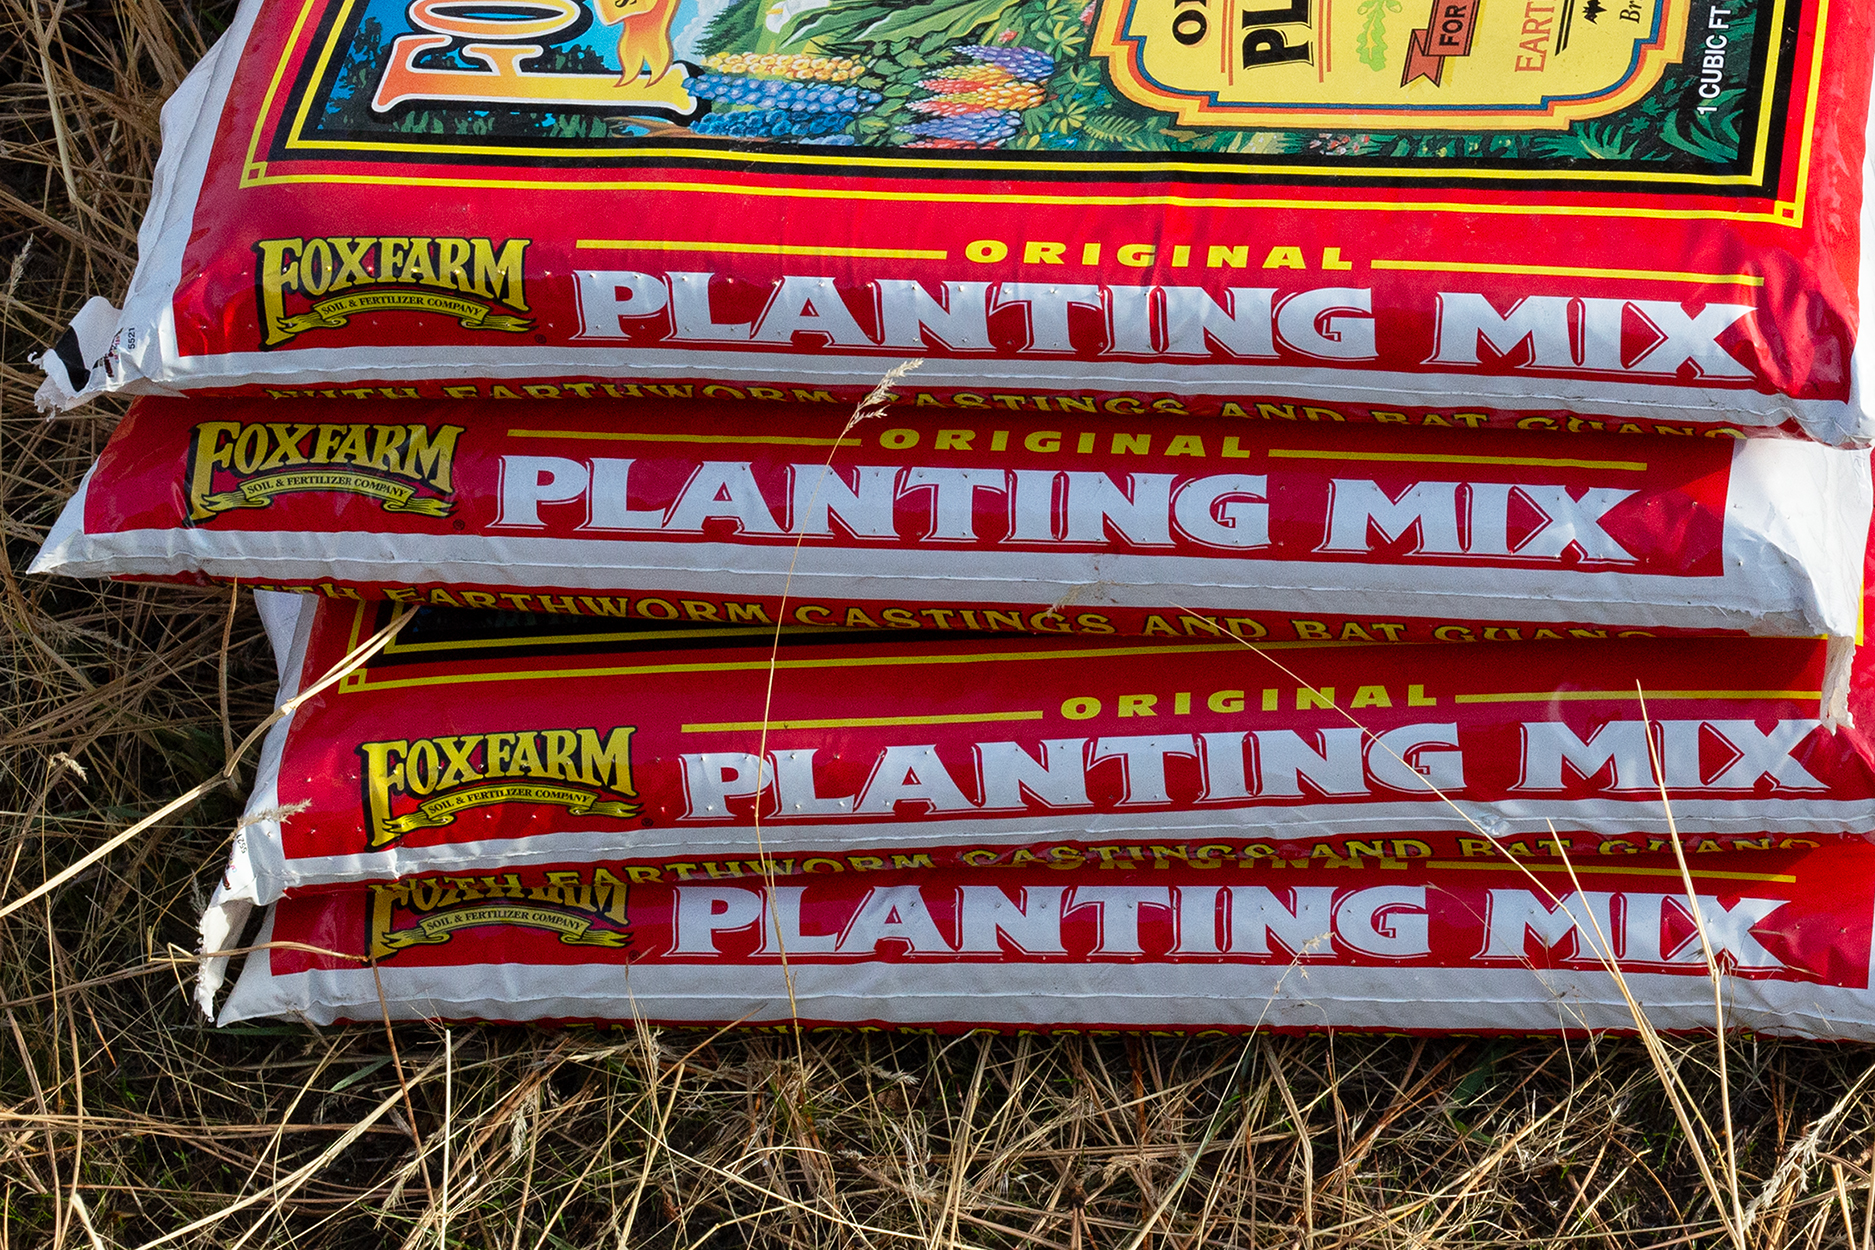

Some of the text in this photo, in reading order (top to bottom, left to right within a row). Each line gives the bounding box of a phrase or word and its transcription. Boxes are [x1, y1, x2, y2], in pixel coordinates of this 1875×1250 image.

[1438, 4, 1465, 47] FOR
[1708, 6, 1731, 30] FT
[1698, 33, 1727, 99] CUBIC
[1698, 106, 1717, 115] 1
[965, 239, 1352, 270] ORIGINAL
[257, 236, 533, 350] FOXFARM
[322, 295, 483, 316] SOIL FERTILIZER COMPANY
[570, 269, 1759, 381] PLANTING MIX
[879, 427, 1253, 458] ORIGINAL
[183, 420, 466, 527] FOXFARM
[247, 476, 408, 497] SOIL FERTILIZER COMPANY
[486, 454, 1641, 565] PLANTING MIX
[383, 588, 1403, 641] EARTHWORM CASTINGS AND BAT
[1061, 684, 1438, 719] ORIGINAL
[361, 726, 639, 851] FOXFARM
[675, 718, 1831, 821] PLANTING MIX
[428, 788, 591, 814] SOIL FERTILIZER COMPANY
[661, 884, 1793, 973] PLANTING MIX
